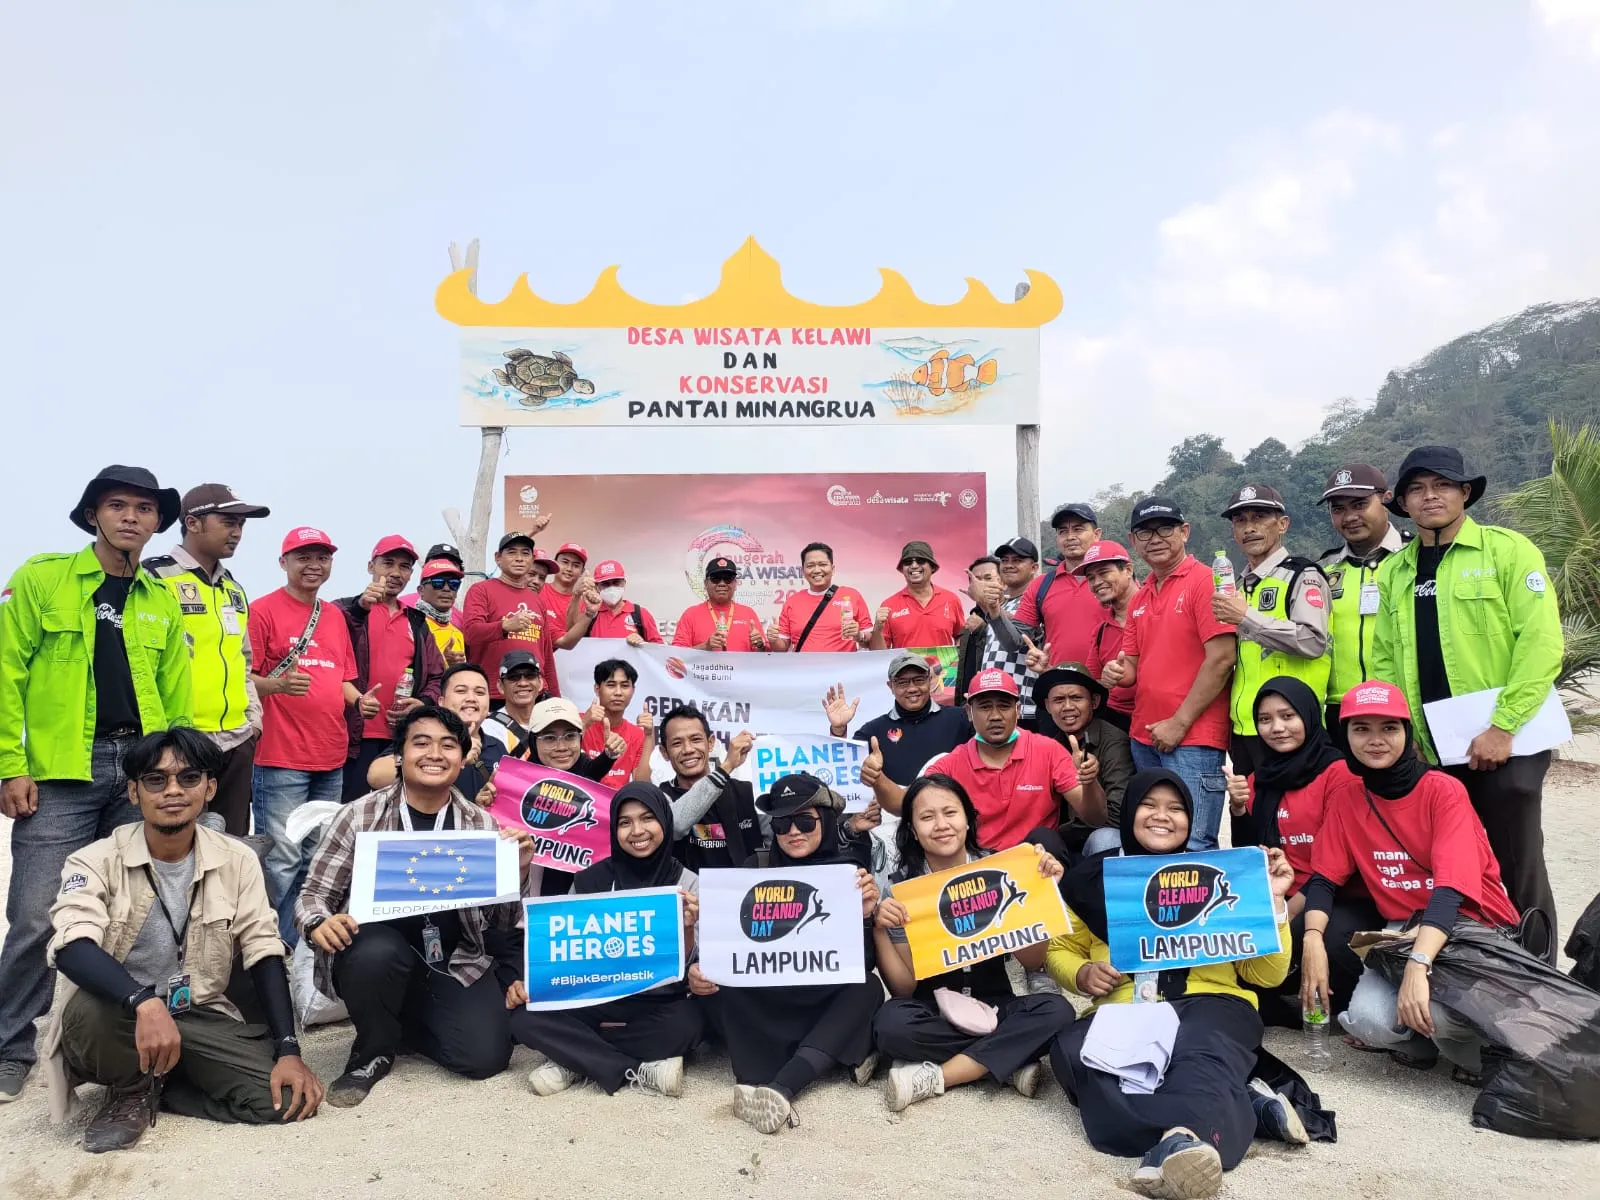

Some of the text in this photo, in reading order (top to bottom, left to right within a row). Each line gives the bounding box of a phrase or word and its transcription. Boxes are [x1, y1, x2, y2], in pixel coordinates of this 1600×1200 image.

[628, 327, 871, 346] DESA WISATA KELAWI
[723, 351, 778, 370] DAN
[679, 375, 828, 395] KONSERVASI
[628, 400, 876, 419] PANTAI MINANGRUA
[736, 566, 804, 580] SA WISAT
[757, 742, 860, 769] PLANET
[759, 765, 862, 792] HOES
[540, 782, 575, 803] WORLD
[526, 807, 549, 825] DAY
[533, 796, 577, 818] CLEANUP
[530, 834, 593, 868] MPUNG
[1158, 870, 1199, 889] WORLD
[1377, 864, 1405, 878] tapi
[947, 877, 987, 902] WORLD
[1381, 877, 1421, 891] tanpa
[754, 886, 795, 903] WORLD
[950, 889, 999, 918] CLEANUP
[1158, 886, 1209, 906] CLEANUP
[752, 902, 803, 921] CLEANUP
[1158, 905, 1181, 922] DAY
[549, 909, 656, 937] PLANET
[750, 920, 774, 937] DAY
[953, 913, 976, 934] DAY
[550, 934, 656, 962] HEROES
[942, 922, 1050, 967] LAMPUNG
[1141, 933, 1256, 960] LAMPUNG
[732, 950, 840, 975] LAMPUNG
[550, 969, 654, 986] #BijakBerplastik
